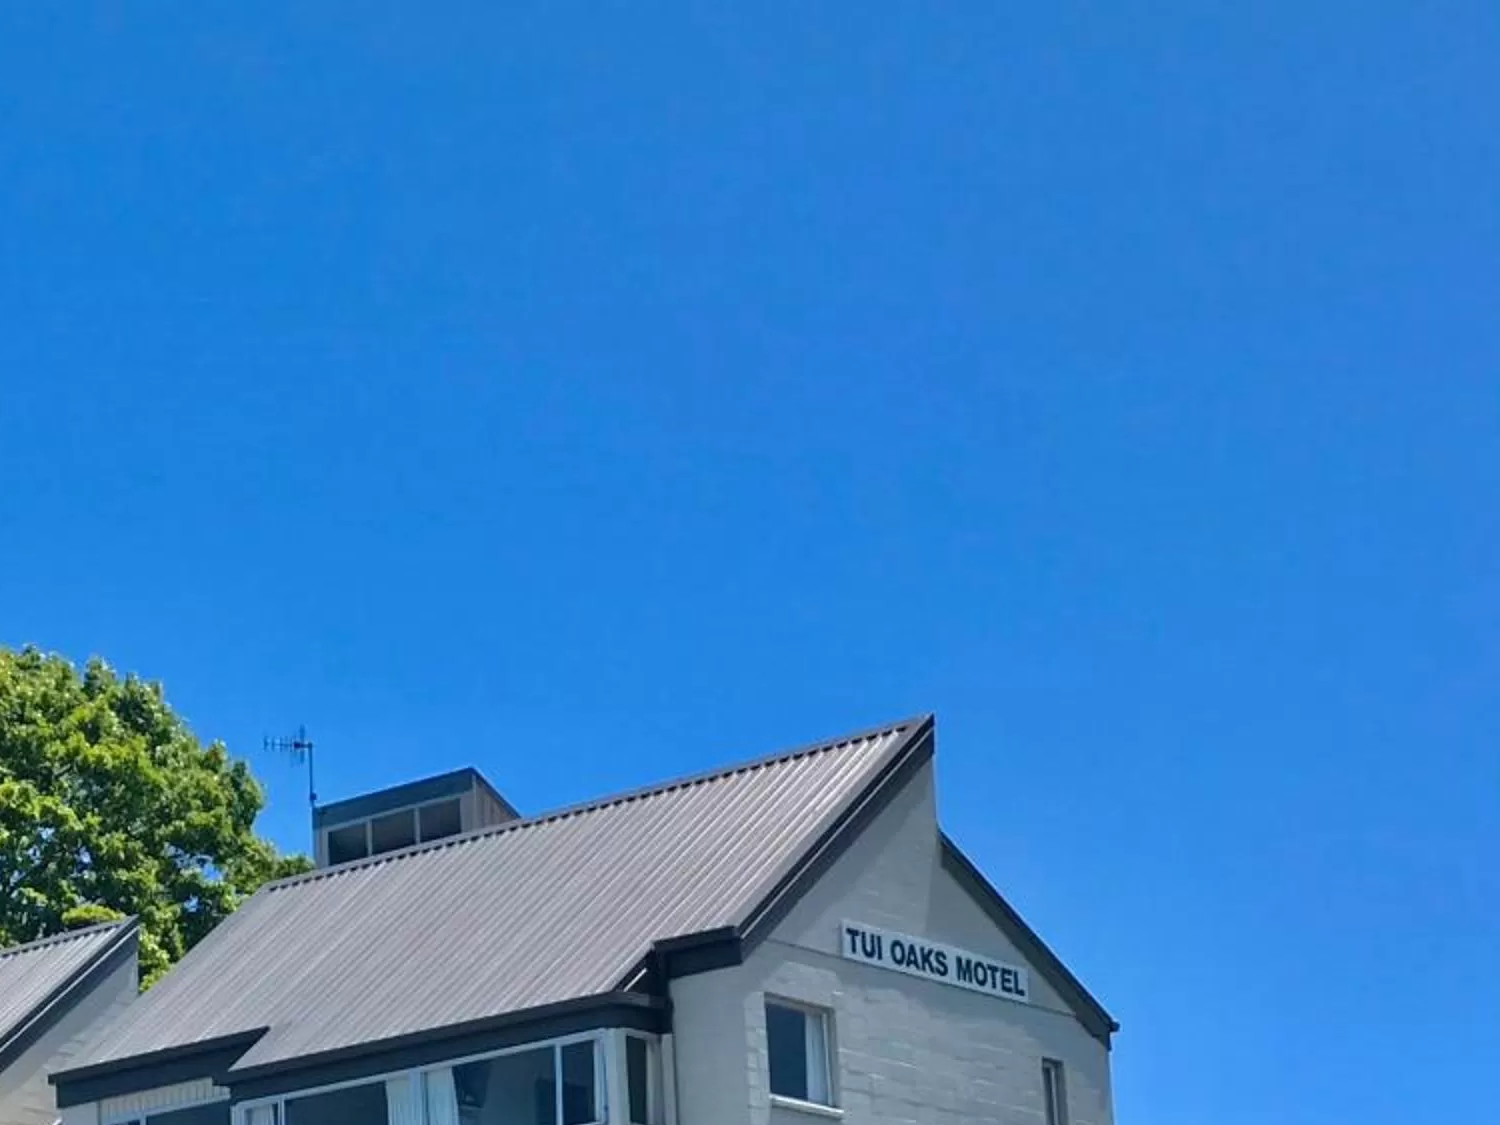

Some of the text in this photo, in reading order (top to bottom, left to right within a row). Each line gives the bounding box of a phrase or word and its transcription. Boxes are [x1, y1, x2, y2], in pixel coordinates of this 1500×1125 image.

[846, 927, 1025, 997] TUI OAKS MOTEL
